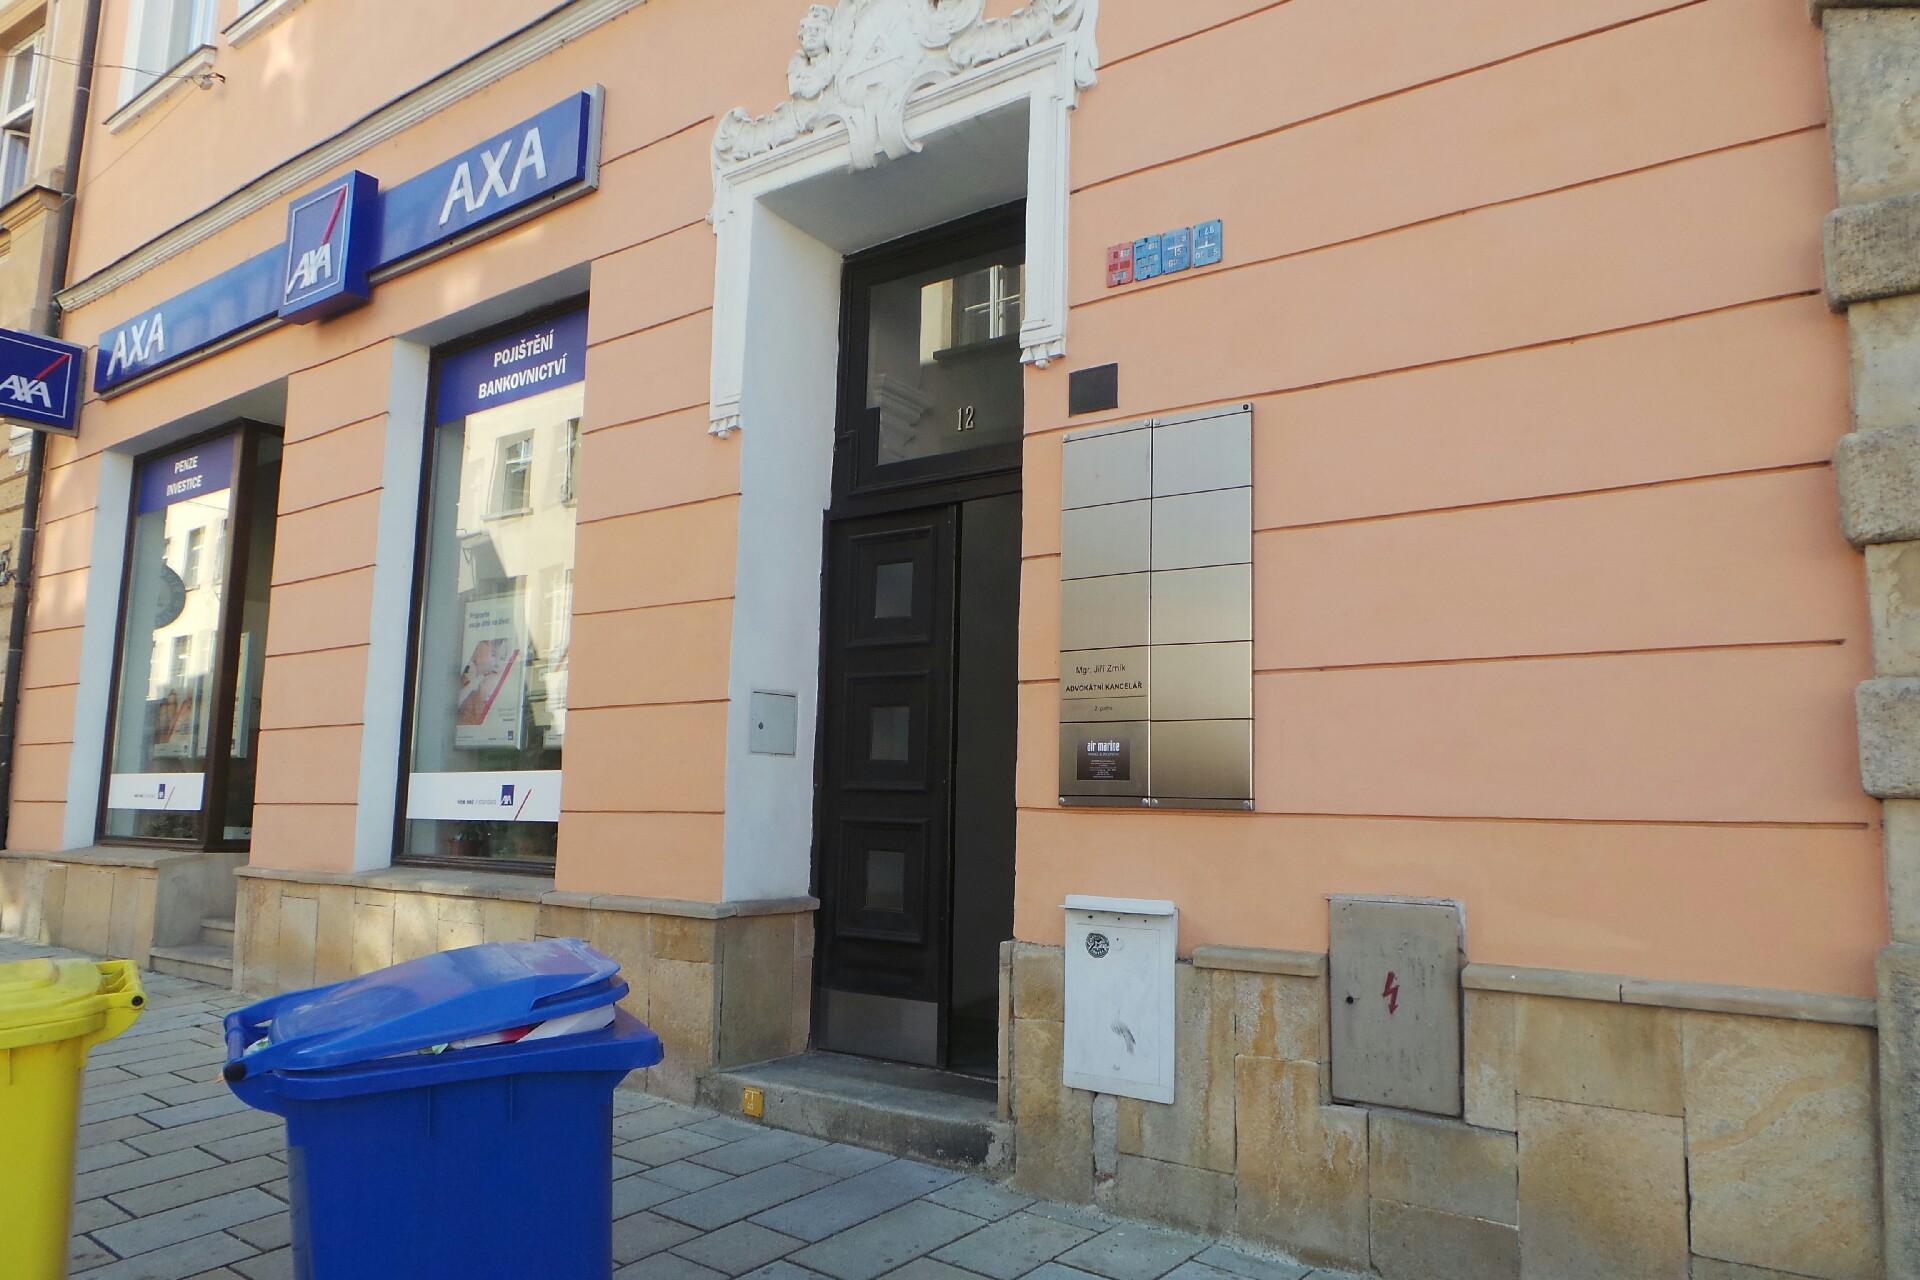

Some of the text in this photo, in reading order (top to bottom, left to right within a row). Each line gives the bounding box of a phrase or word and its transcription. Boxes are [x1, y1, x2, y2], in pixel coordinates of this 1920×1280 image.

[439, 127, 548, 226] AXA
[286, 243, 333, 295] AXA
[107, 312, 165, 378] AXA
[493, 328, 555, 368] POJIŠTĚNÍ
[0, 374, 53, 409] AXA
[478, 352, 568, 399] BANKOVNICTVÍ
[957, 405, 974, 431] 12
[174, 455, 199, 474] PENZE
[166, 474, 203, 497] INVESTICE
[1066, 681, 1143, 692] ADVOKÁTNÍ KANCELÁŘ
[1087, 740, 1097, 752] air
